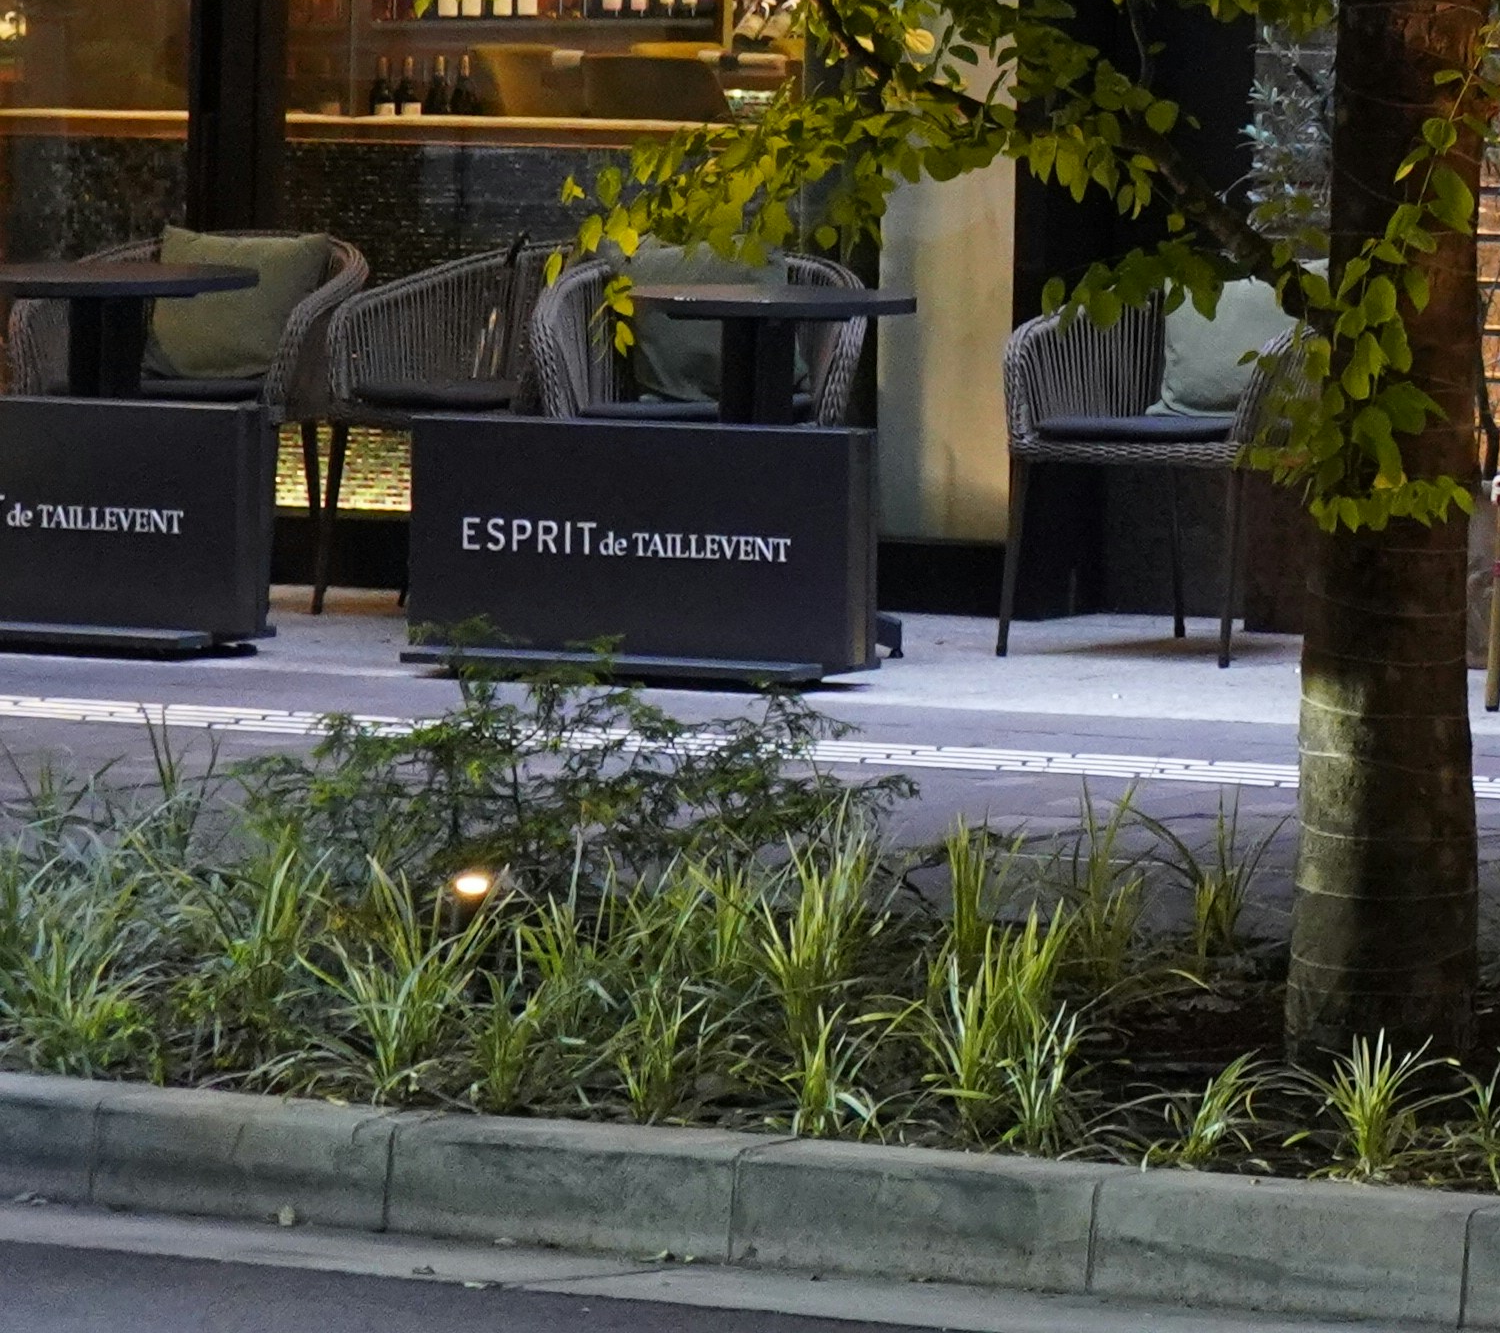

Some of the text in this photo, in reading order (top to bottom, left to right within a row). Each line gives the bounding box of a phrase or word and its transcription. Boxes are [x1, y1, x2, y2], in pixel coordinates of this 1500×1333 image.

[6, 502, 184, 534] de TAILLEVENT
[461, 516, 792, 563] ESPRIT de TAILLEVENT
